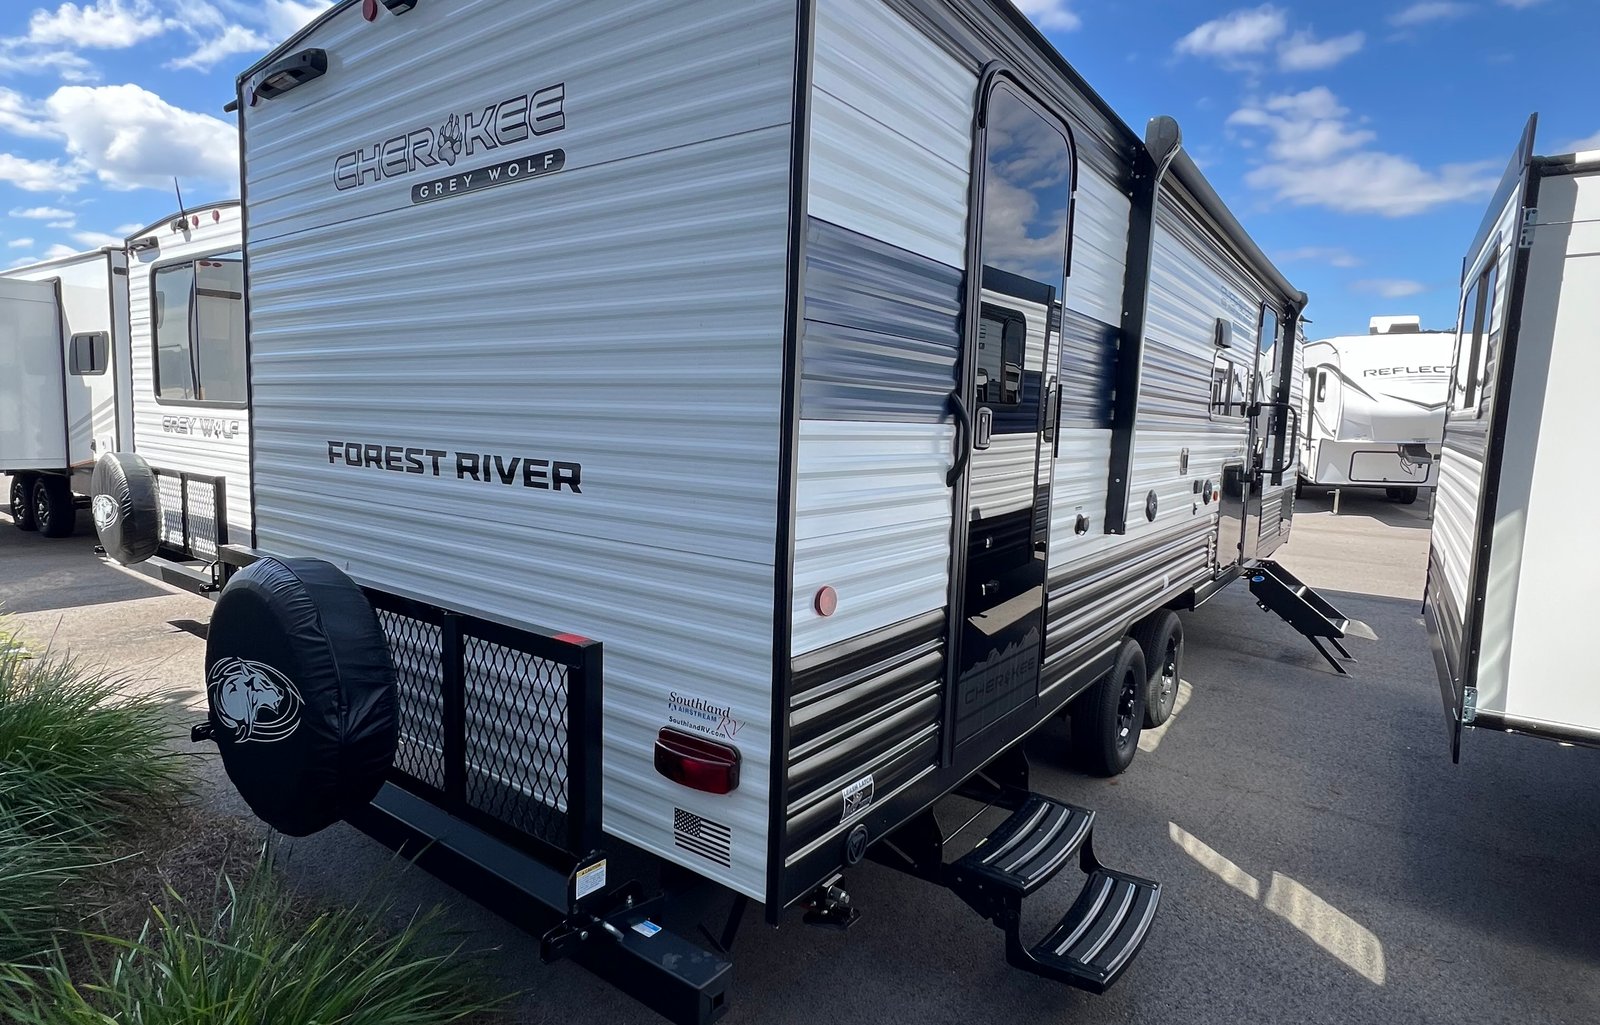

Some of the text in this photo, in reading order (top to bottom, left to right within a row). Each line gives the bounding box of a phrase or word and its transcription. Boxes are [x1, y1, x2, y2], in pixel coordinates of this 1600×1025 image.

[420, 154, 554, 198] GREY WOLF
[162, 415, 197, 435] GREY
[327, 440, 582, 494] FOREST RIVER
[668, 691, 731, 718] Southland
[678, 706, 717, 722] AIRSTREAM
[668, 715, 726, 738] SouthlandRV.com
